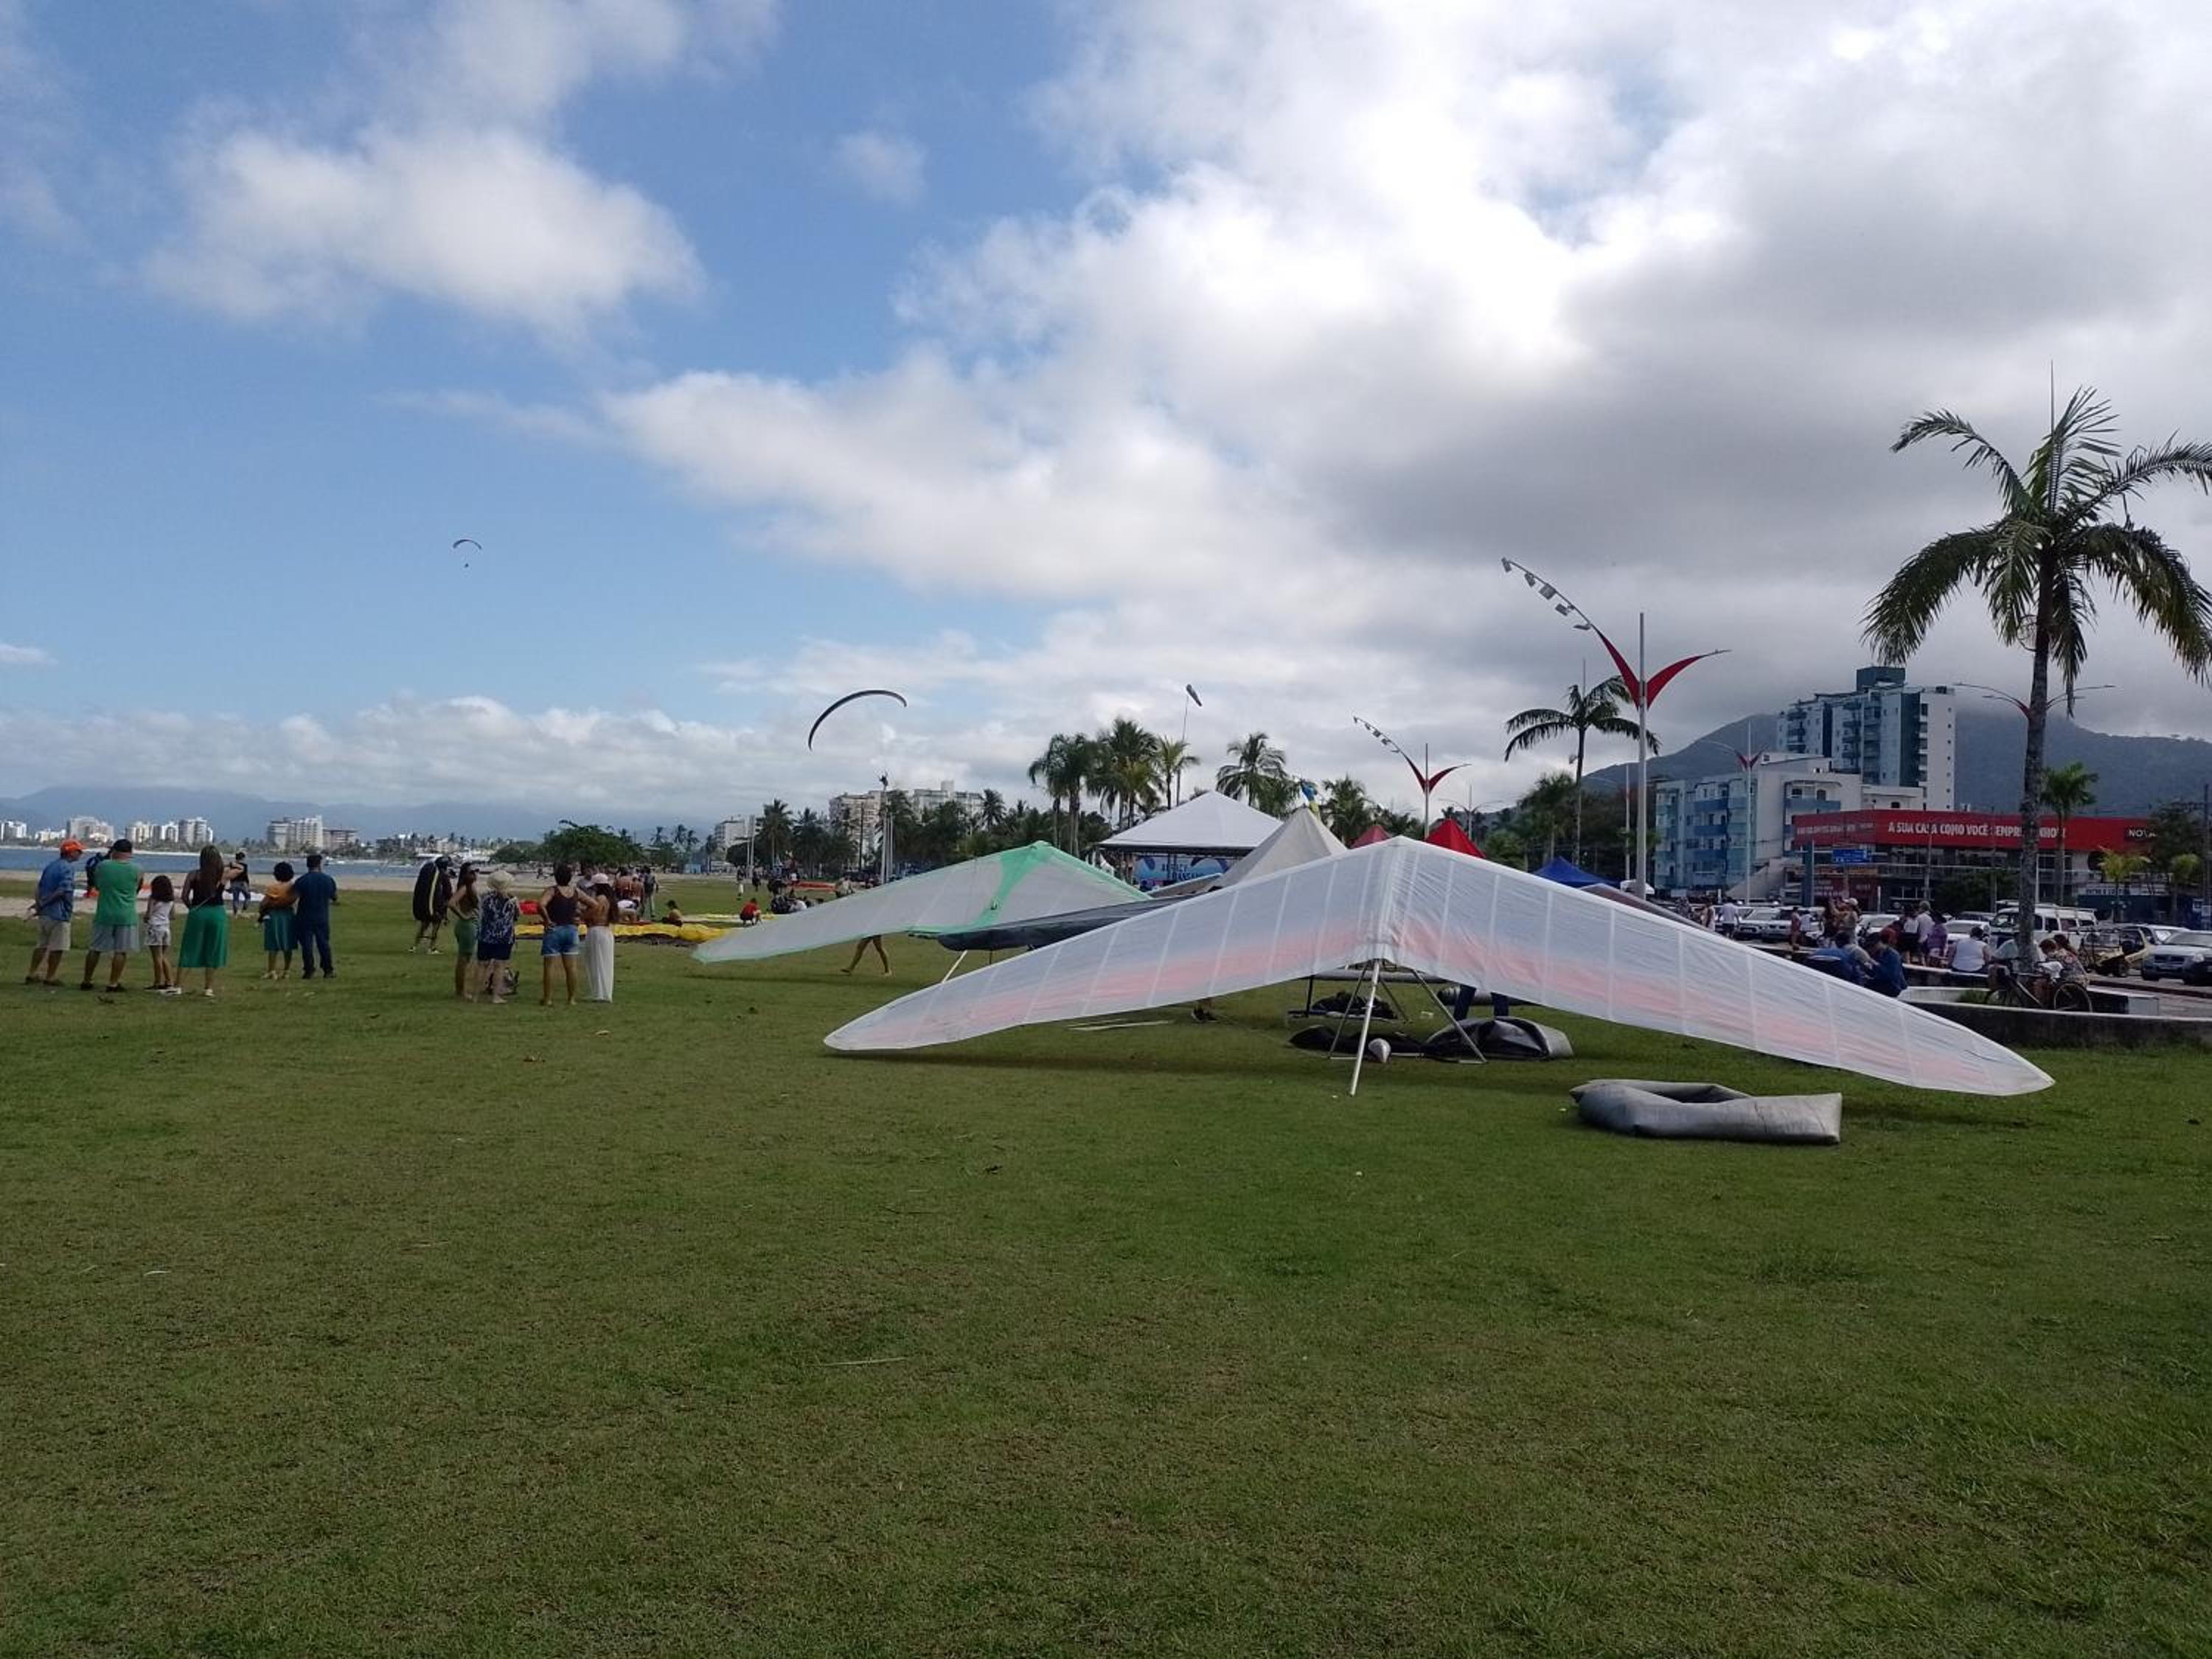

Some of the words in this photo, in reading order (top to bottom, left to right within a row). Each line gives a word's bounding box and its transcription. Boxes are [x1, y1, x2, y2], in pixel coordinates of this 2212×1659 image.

[1888, 821, 1896, 833] A
[1896, 822, 1914, 834] SUA
[1940, 823, 1965, 836] COMO
[1966, 822, 1989, 836] VOCÊ
